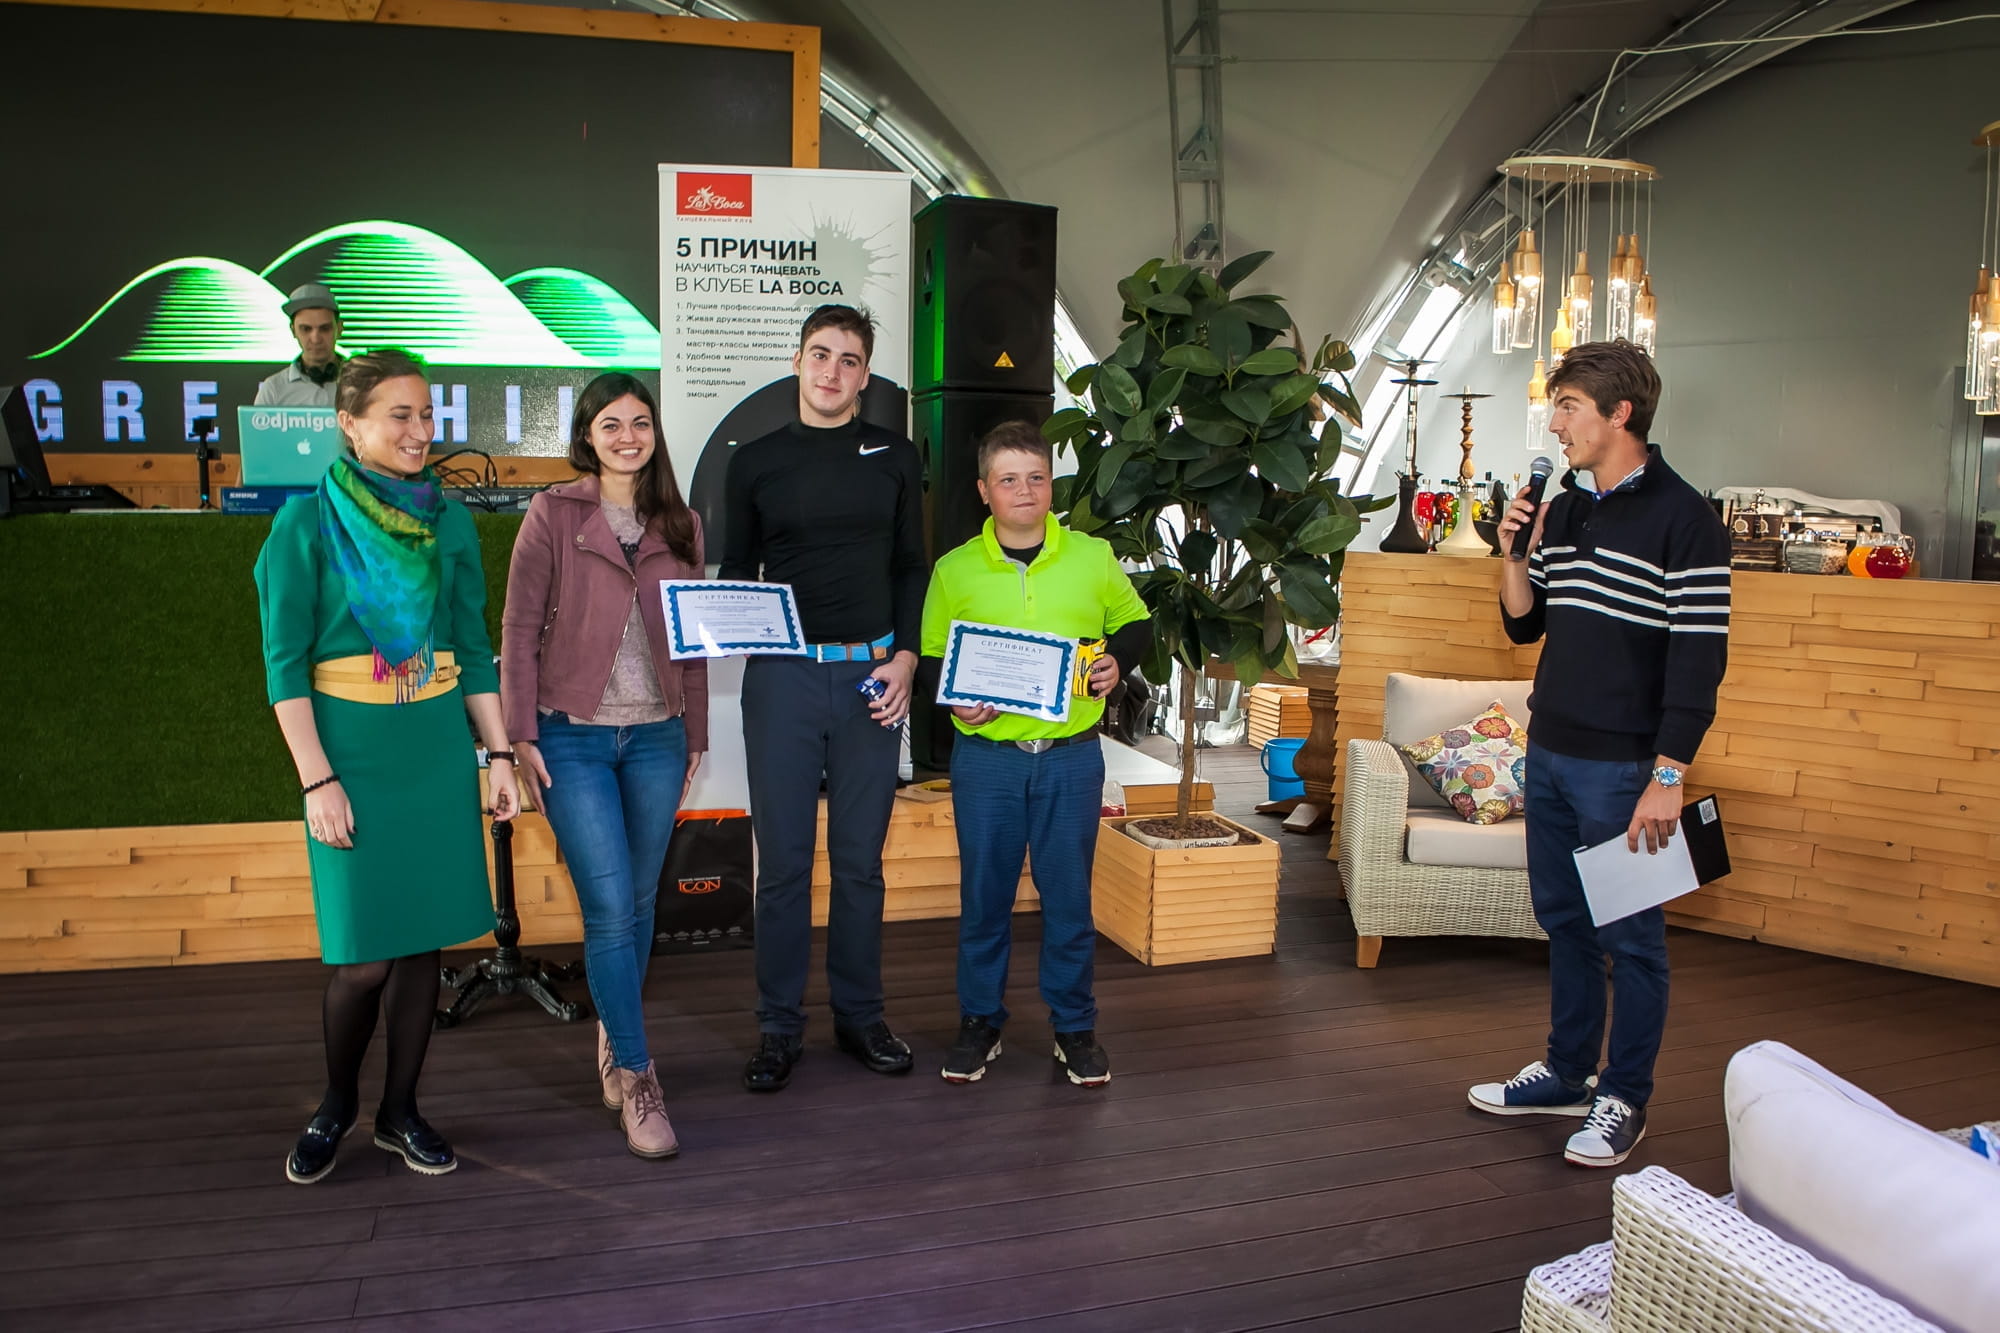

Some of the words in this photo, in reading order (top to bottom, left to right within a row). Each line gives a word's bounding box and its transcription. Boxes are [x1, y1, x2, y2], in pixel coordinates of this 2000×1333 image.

[685, 195, 706, 209] La
[710, 194, 745, 210] Boca
[676, 237, 691, 258] 5
[700, 237, 817, 261] ПРИЧИН
[675, 263, 747, 274] НАУЧИТЬСЯ
[750, 265, 821, 277] ТАНЦЕВАТЬ
[675, 277, 688, 292] В
[694, 278, 754, 294] КЛУБЕ
[760, 279, 783, 294] LA
[789, 280, 844, 296] BOCA
[686, 302, 718, 311] Лучшие
[721, 303, 801, 313] профессиональные
[686, 315, 714, 323] Живая
[716, 316, 761, 325] дружеская
[763, 317, 805, 326] атмосфер
[686, 328, 745, 337] Танцевальные
[686, 341, 750, 350] мастер-классы
[752, 342, 788, 351] мировых
[686, 352, 721, 361] Удобное
[686, 365, 732, 374] Искренние
[686, 378, 746, 387] неподдельные
[23, 378, 264, 442] GRE
[981, 639, 1044, 655] СЕРТИФИКАТ
